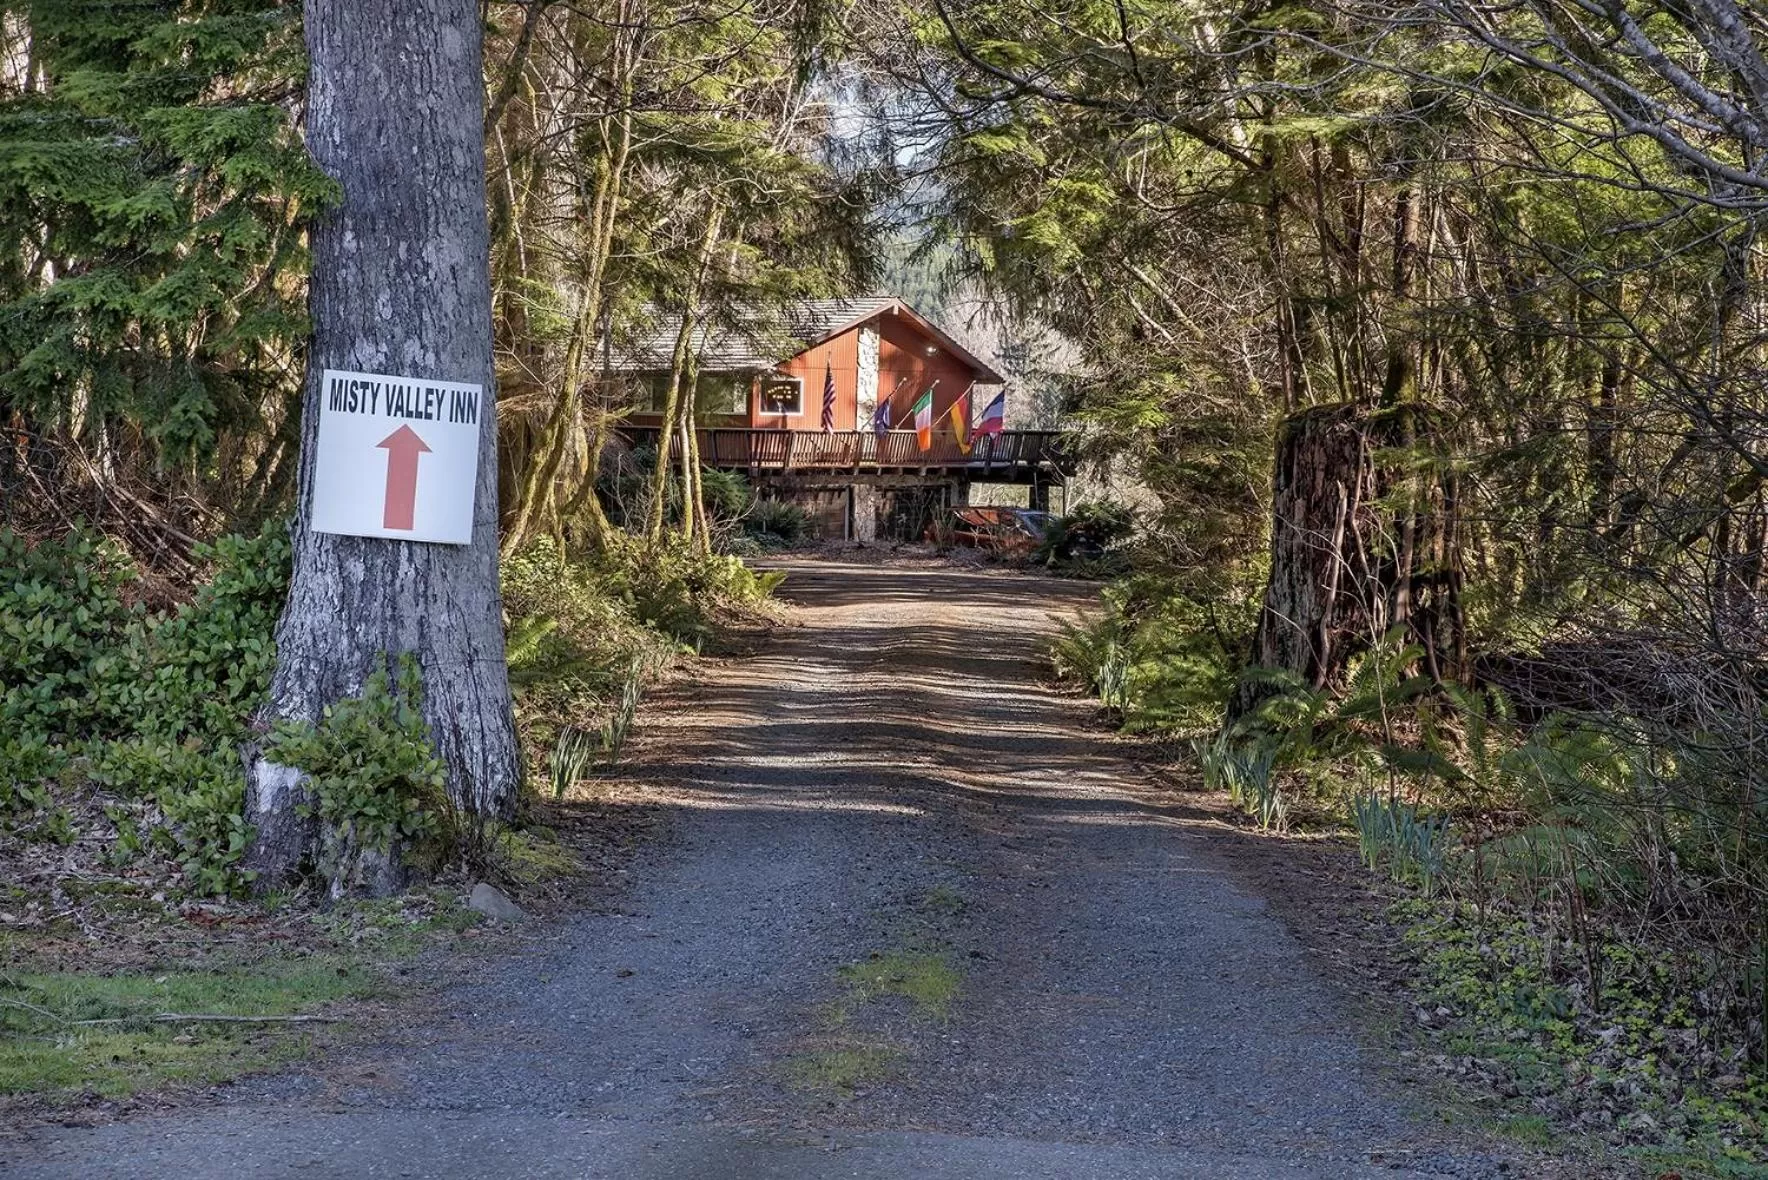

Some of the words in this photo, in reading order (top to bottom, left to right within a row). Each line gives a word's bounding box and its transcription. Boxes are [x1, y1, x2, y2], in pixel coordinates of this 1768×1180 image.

[329, 378, 381, 415] MISTY
[385, 383, 446, 421] VALLEY
[449, 390, 478, 425] INN
